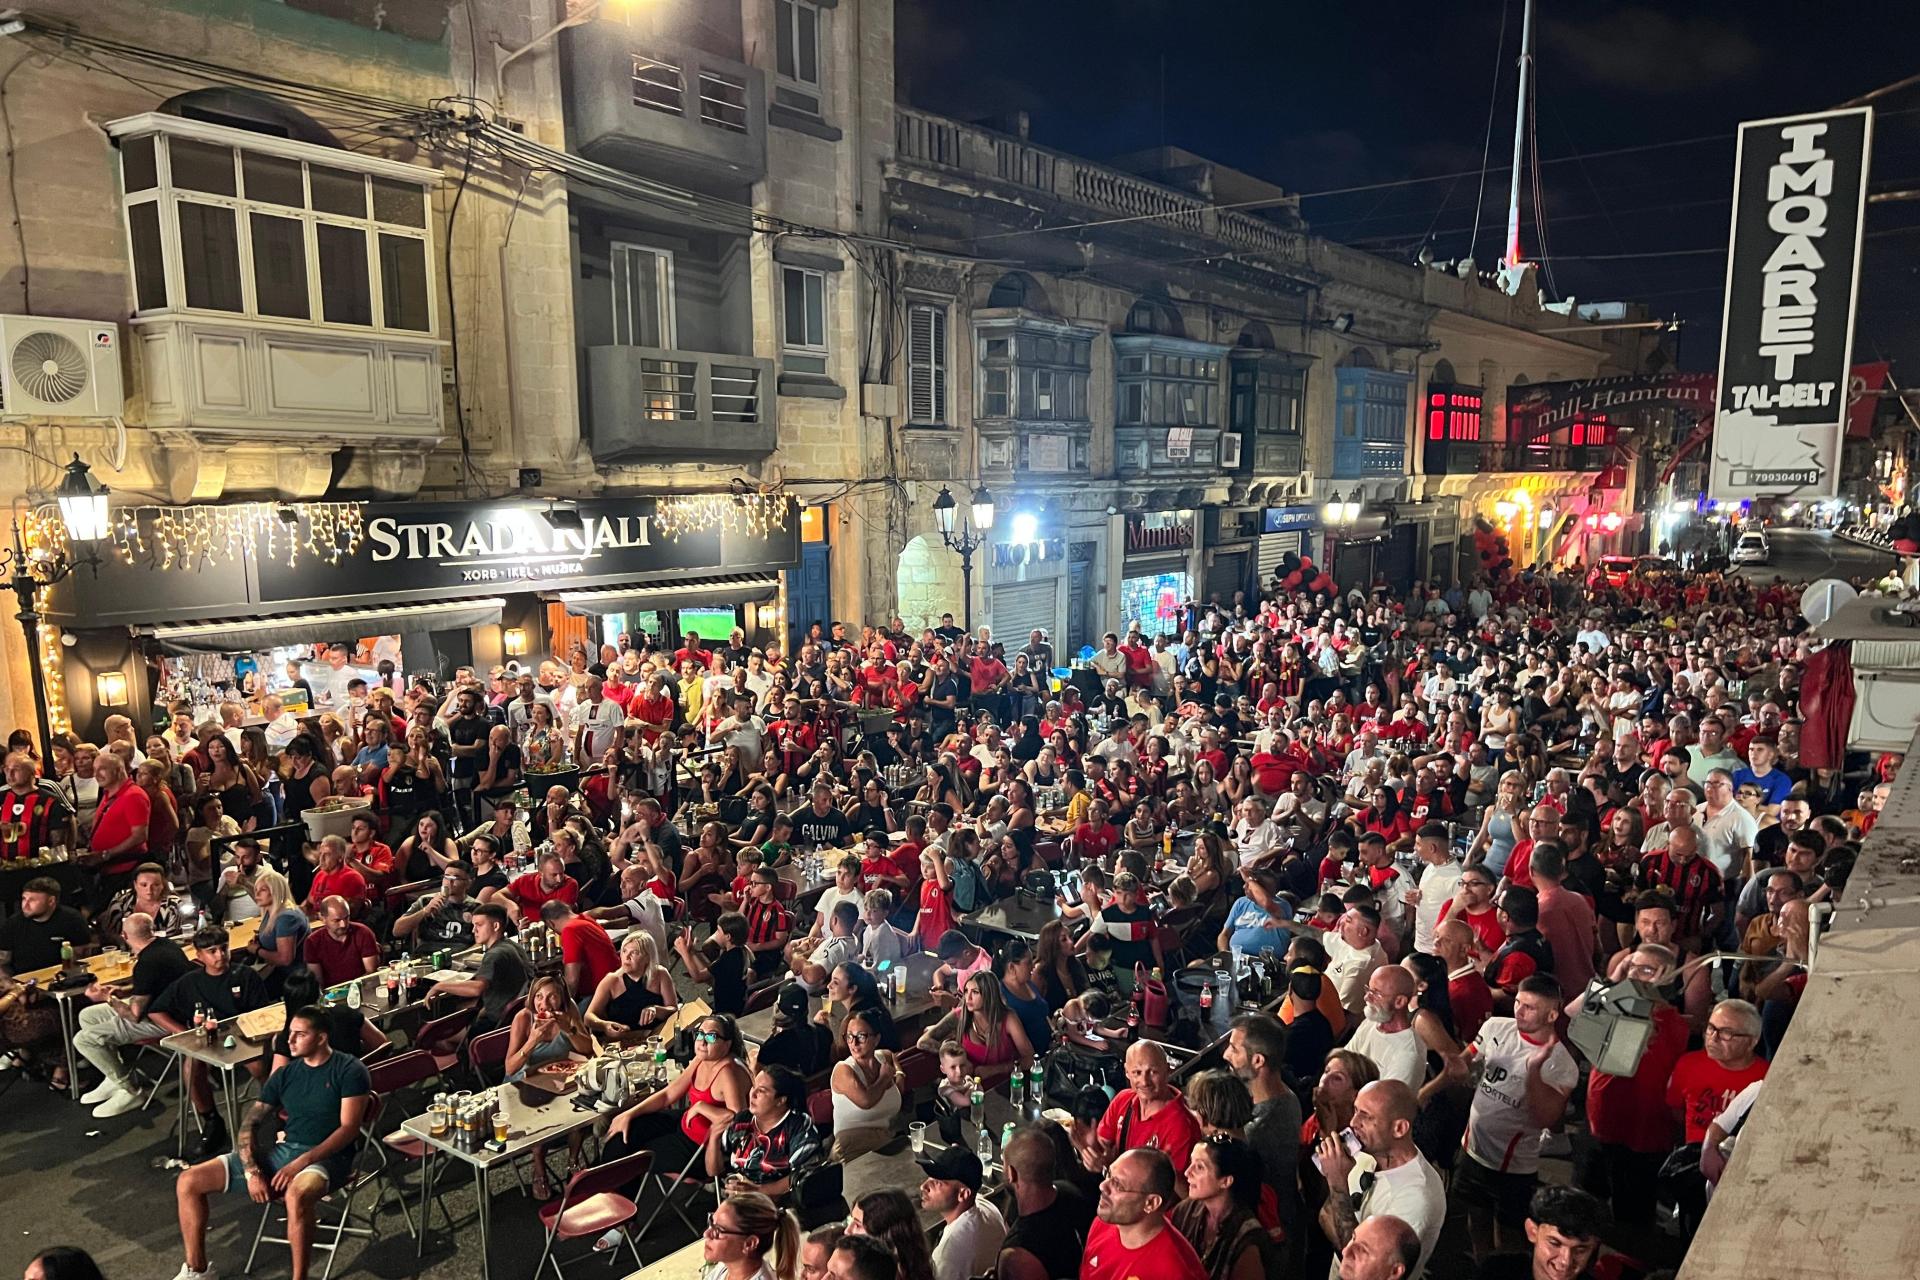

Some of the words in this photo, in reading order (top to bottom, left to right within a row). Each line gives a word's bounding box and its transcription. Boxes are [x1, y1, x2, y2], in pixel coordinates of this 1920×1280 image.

[1758, 122, 1834, 381] IMQARET
[1731, 382, 1836, 409] TAL-BELT
[463, 568, 498, 582] XORB
[507, 566, 534, 579] IKEL
[1485, 1066, 1508, 1084] JP
